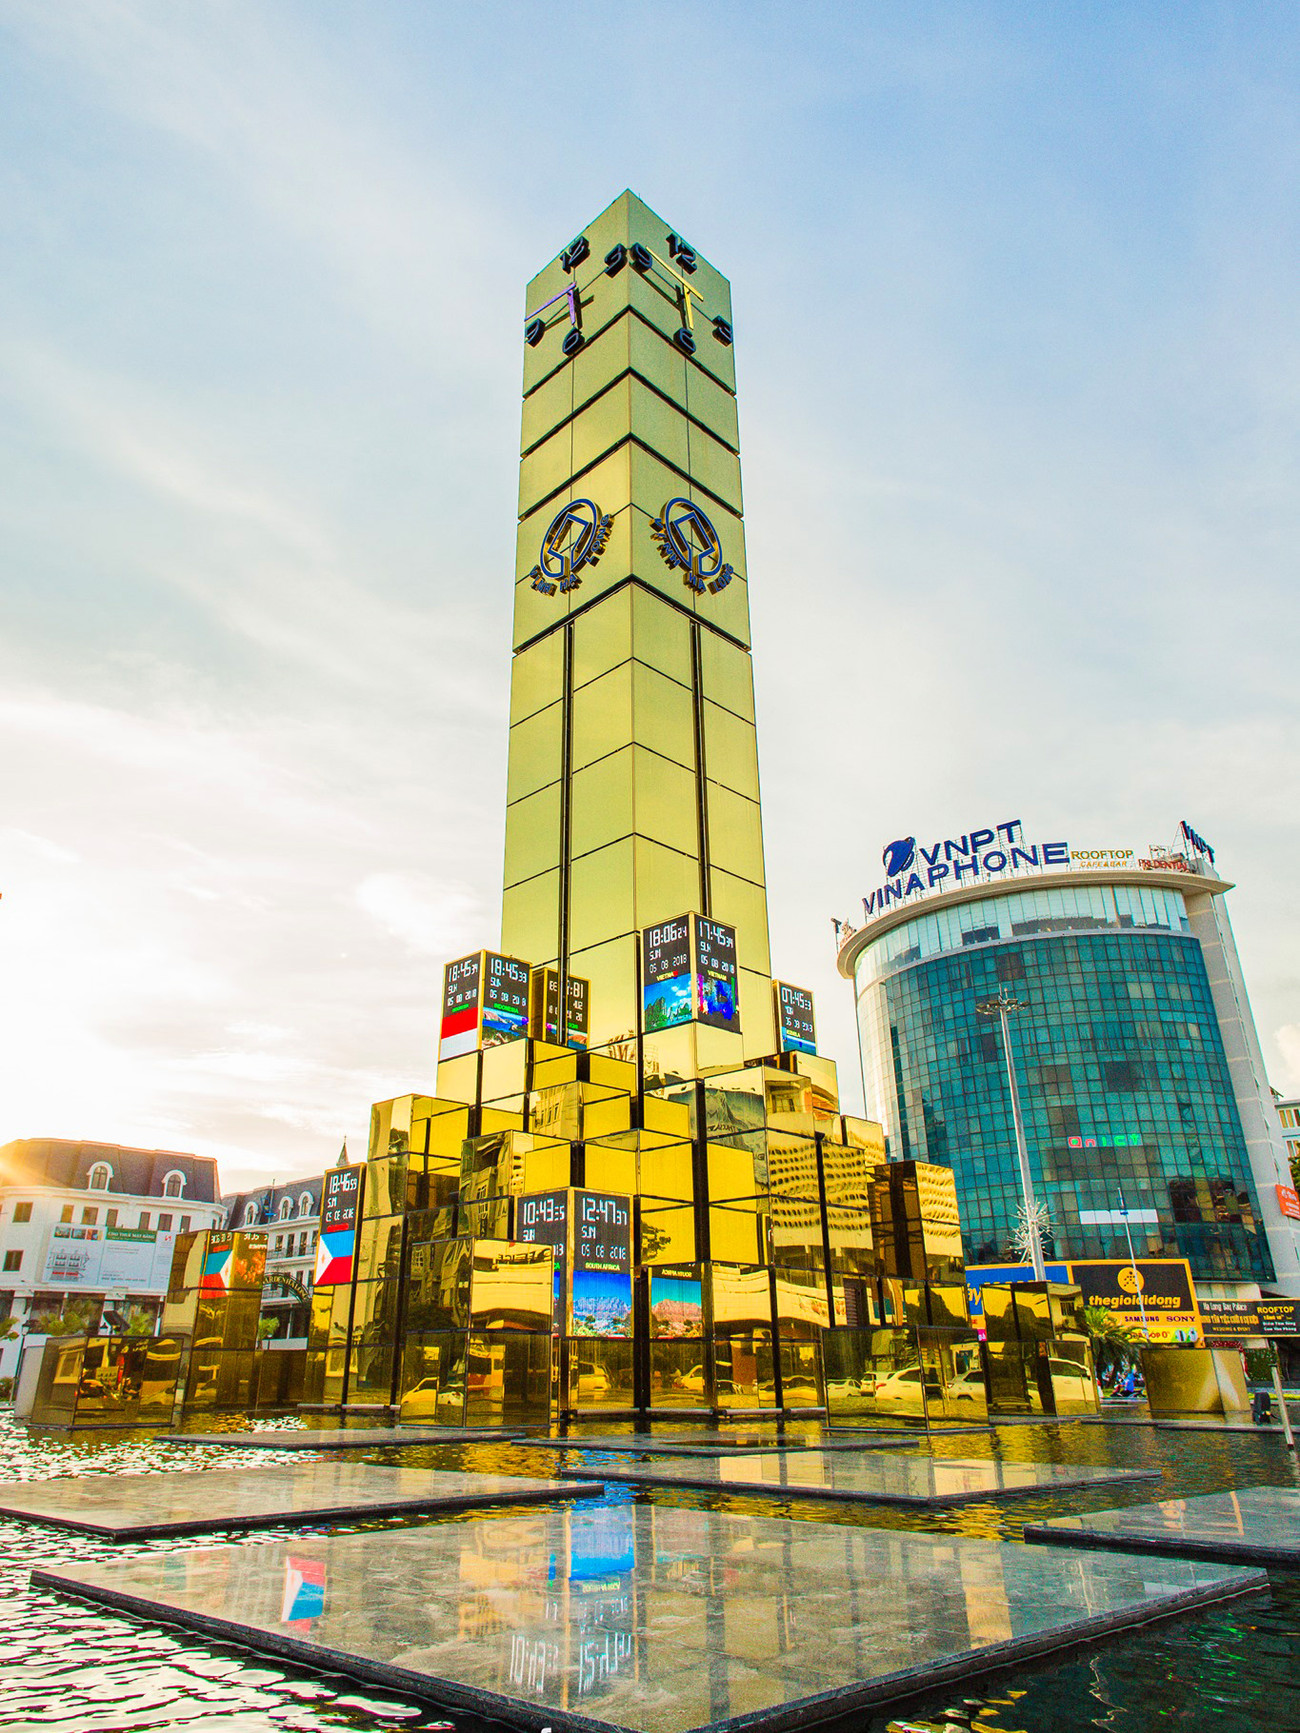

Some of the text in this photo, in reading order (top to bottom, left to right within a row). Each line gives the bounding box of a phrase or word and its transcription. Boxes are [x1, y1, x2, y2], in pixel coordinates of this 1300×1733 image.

[561, 235, 590, 275] 12
[666, 233, 698, 276] 12
[919, 819, 1022, 866] VNPT
[1070, 850, 1134, 860] ROOFTOP
[862, 842, 1070, 915] VINAPHONE
[649, 922, 677, 948] 18:06
[699, 920, 725, 946] 17:45
[448, 959, 472, 983] 18:45
[490, 957, 518, 981] 18:45
[672, 953, 687, 966] 2018
[781, 986, 804, 1009] 07:45
[523, 1198, 554, 1226] 10:43
[582, 1196, 627, 1226] 12:47 37
[585, 1261, 620, 1271] SOUTH AFRICA
[1089, 1294, 1181, 1308] thegioididong
[1256, 1306, 1295, 1314] ROOFTOP
